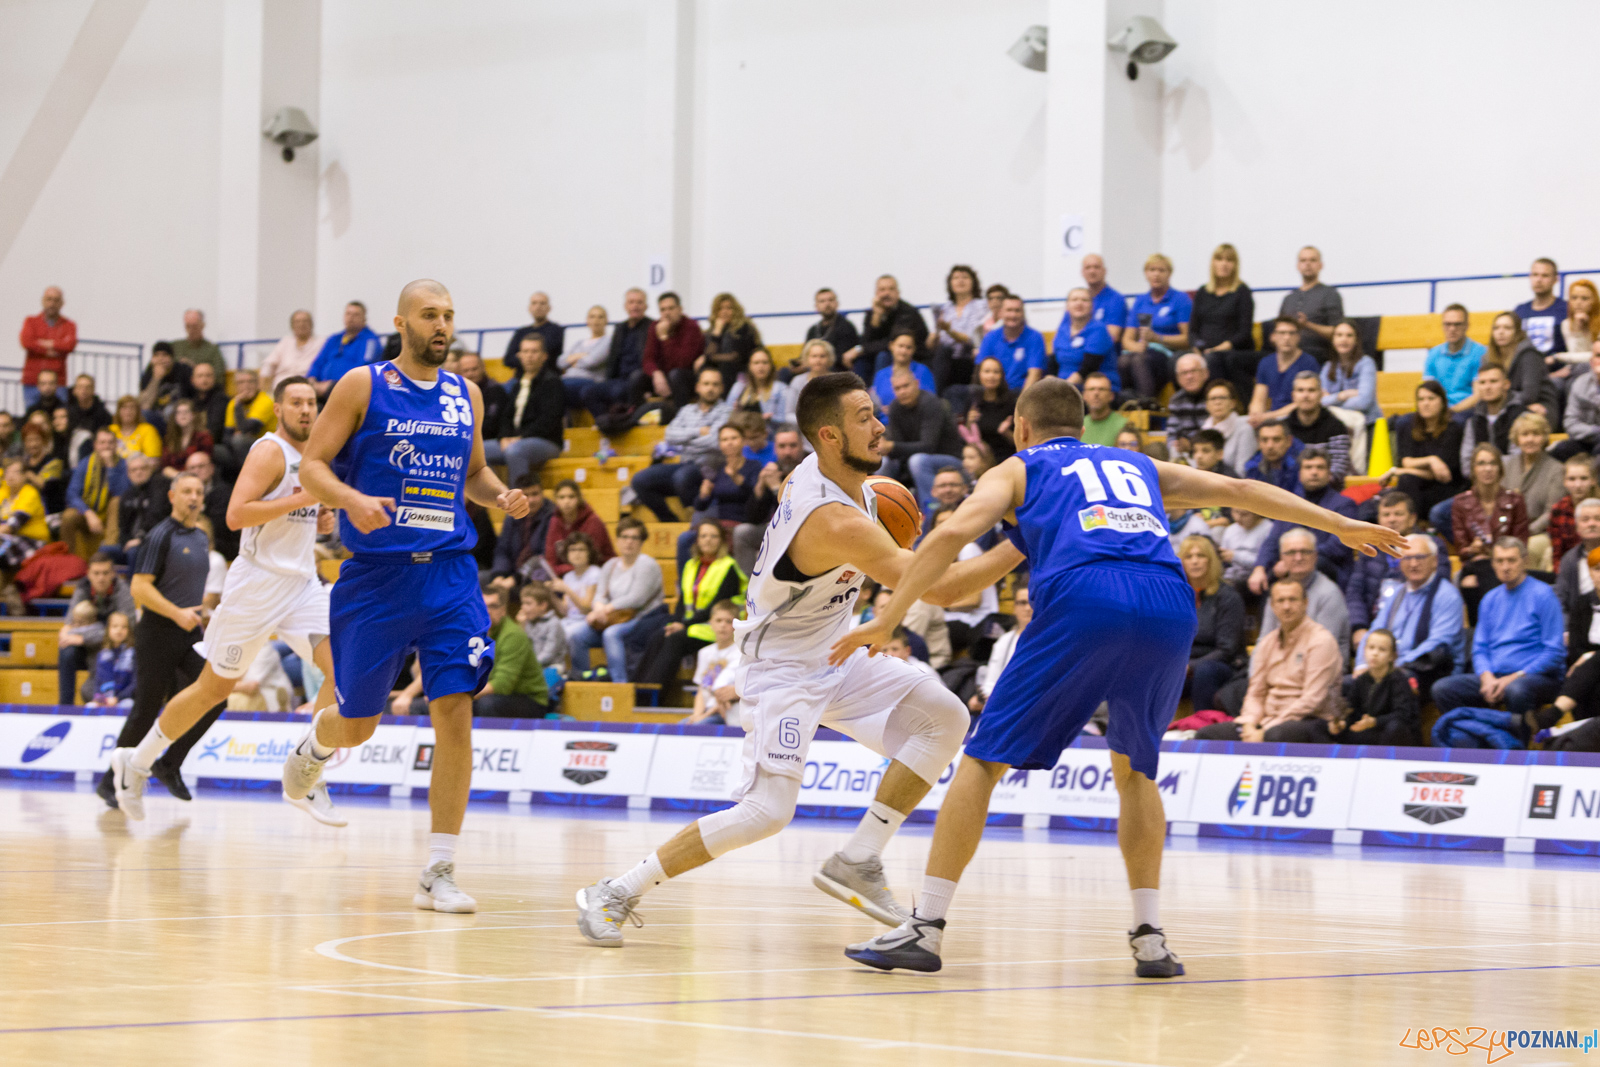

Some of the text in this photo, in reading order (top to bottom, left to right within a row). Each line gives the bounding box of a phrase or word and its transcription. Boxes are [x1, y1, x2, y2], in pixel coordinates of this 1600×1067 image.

[1064, 225, 1083, 250] C
[651, 264, 665, 286] D
[439, 395, 473, 427] 33
[386, 418, 459, 437] Polfarmex
[409, 451, 464, 471] KUTNO
[409, 468, 447, 479] miasto
[1061, 457, 1152, 507] 16
[225, 644, 243, 665] 9
[778, 717, 801, 749] 6
[360, 744, 405, 763] DELIK
[471, 748, 521, 772] CKEL
[567, 753, 608, 767] JOKER
[1260, 761, 1322, 774] fundacja
[1050, 764, 1181, 795] BIOFM
[1253, 775, 1317, 818] PBG
[1410, 786, 1464, 803] JOKER
